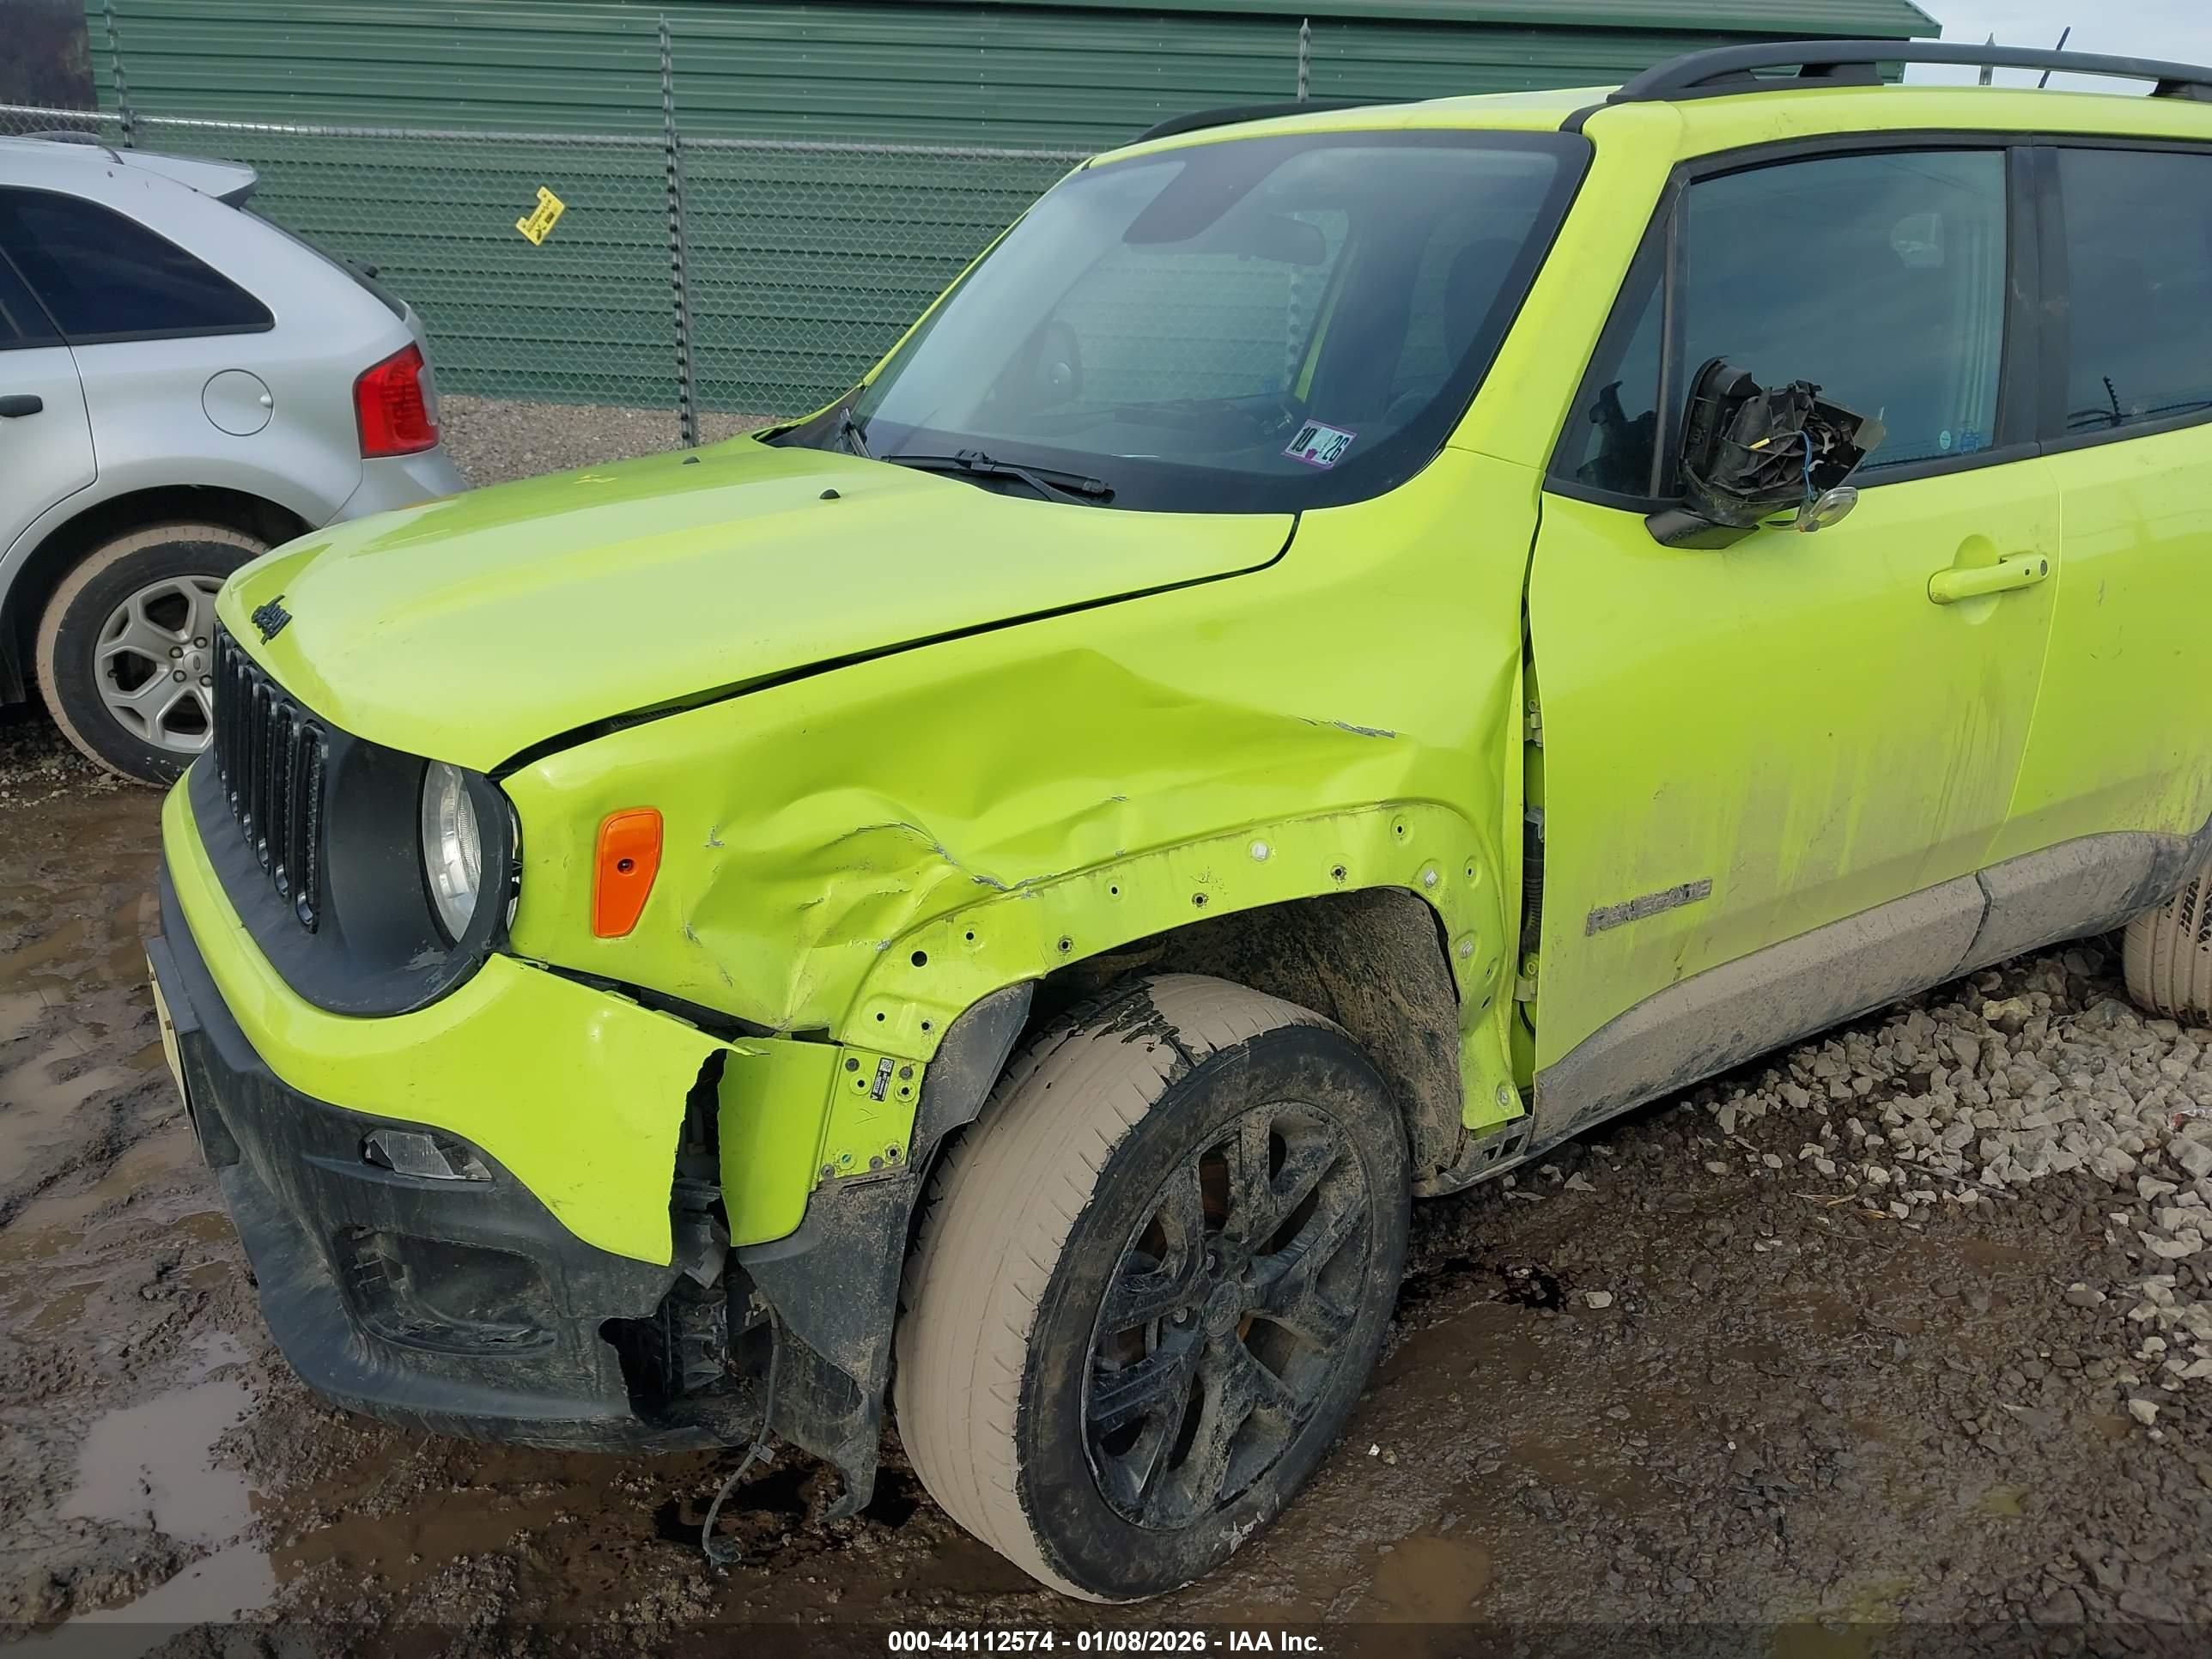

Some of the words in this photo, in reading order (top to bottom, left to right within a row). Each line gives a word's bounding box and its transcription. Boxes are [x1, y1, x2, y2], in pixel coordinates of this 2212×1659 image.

[1291, 426, 1318, 453] 10
[1322, 434, 1350, 462] 26
[1585, 878, 1713, 937] RENEGADE
